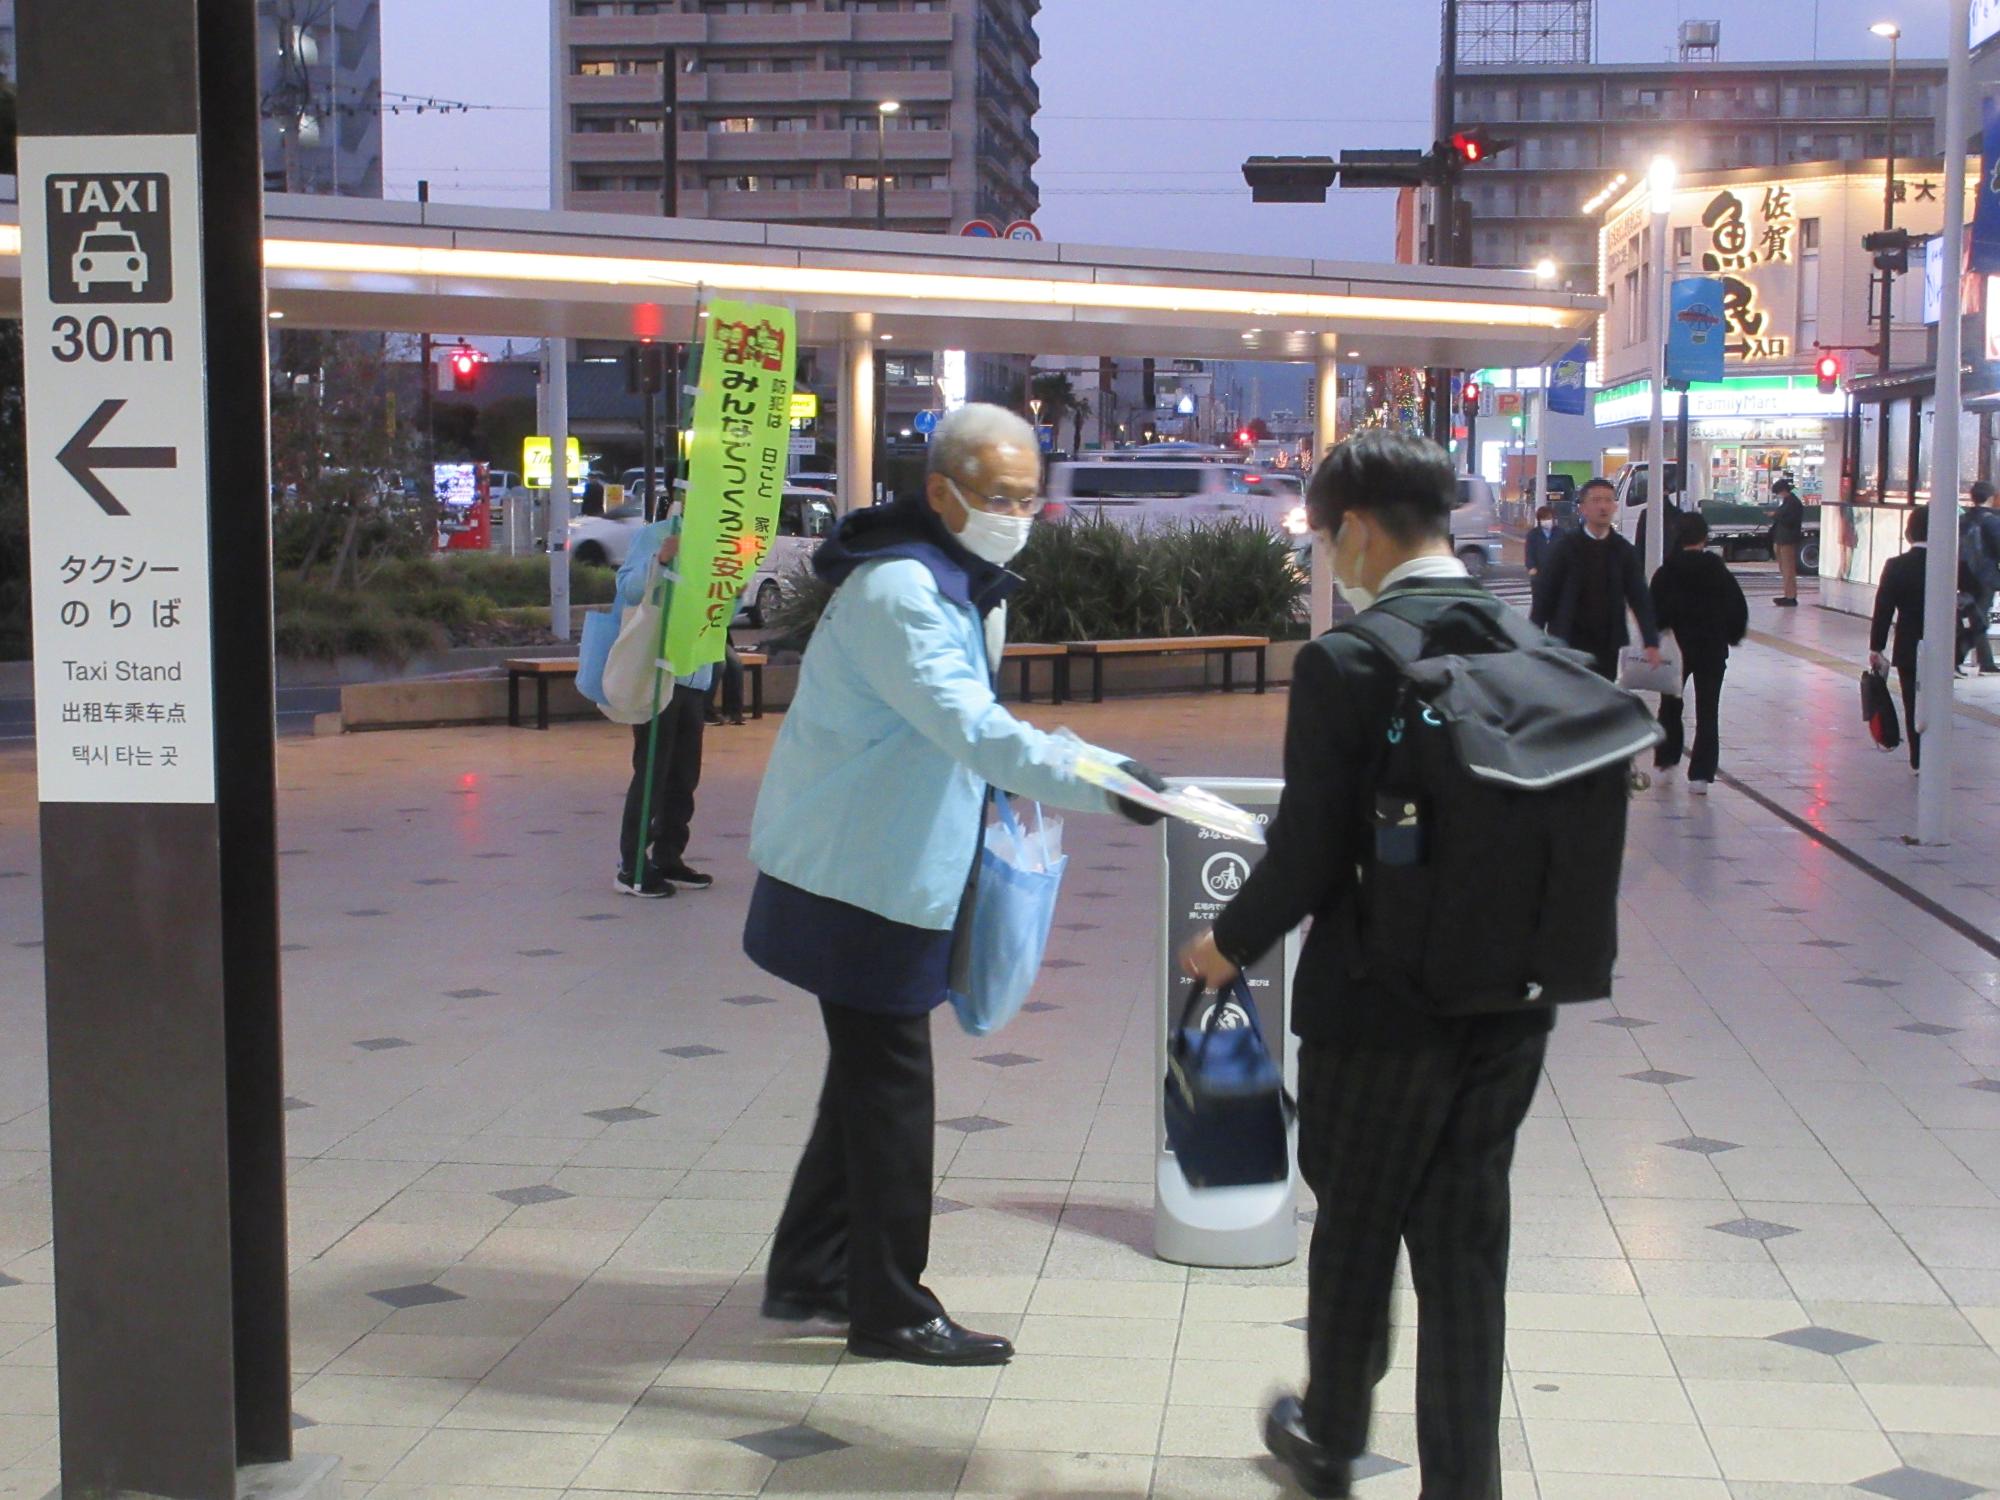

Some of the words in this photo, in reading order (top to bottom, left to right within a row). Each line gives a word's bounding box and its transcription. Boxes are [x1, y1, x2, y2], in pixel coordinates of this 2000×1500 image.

[55, 180, 157, 213] TAXI
[1760, 186, 1792, 262] 佐賀
[1702, 190, 1763, 336] 魚民
[52, 315, 173, 362] 30m
[1752, 339, 1784, 357] 入口
[1697, 395, 1777, 414] FamilyMart
[60, 555, 179, 584] タクシー
[60, 598, 182, 628] のりば
[62, 661, 108, 681] Taxi
[115, 661, 182, 681] Stand
[62, 702, 186, 724] 出租车乘车点
[72, 745, 109, 767] 택시
[116, 745, 153, 767] 타는
[160, 745, 178, 767] 곳
